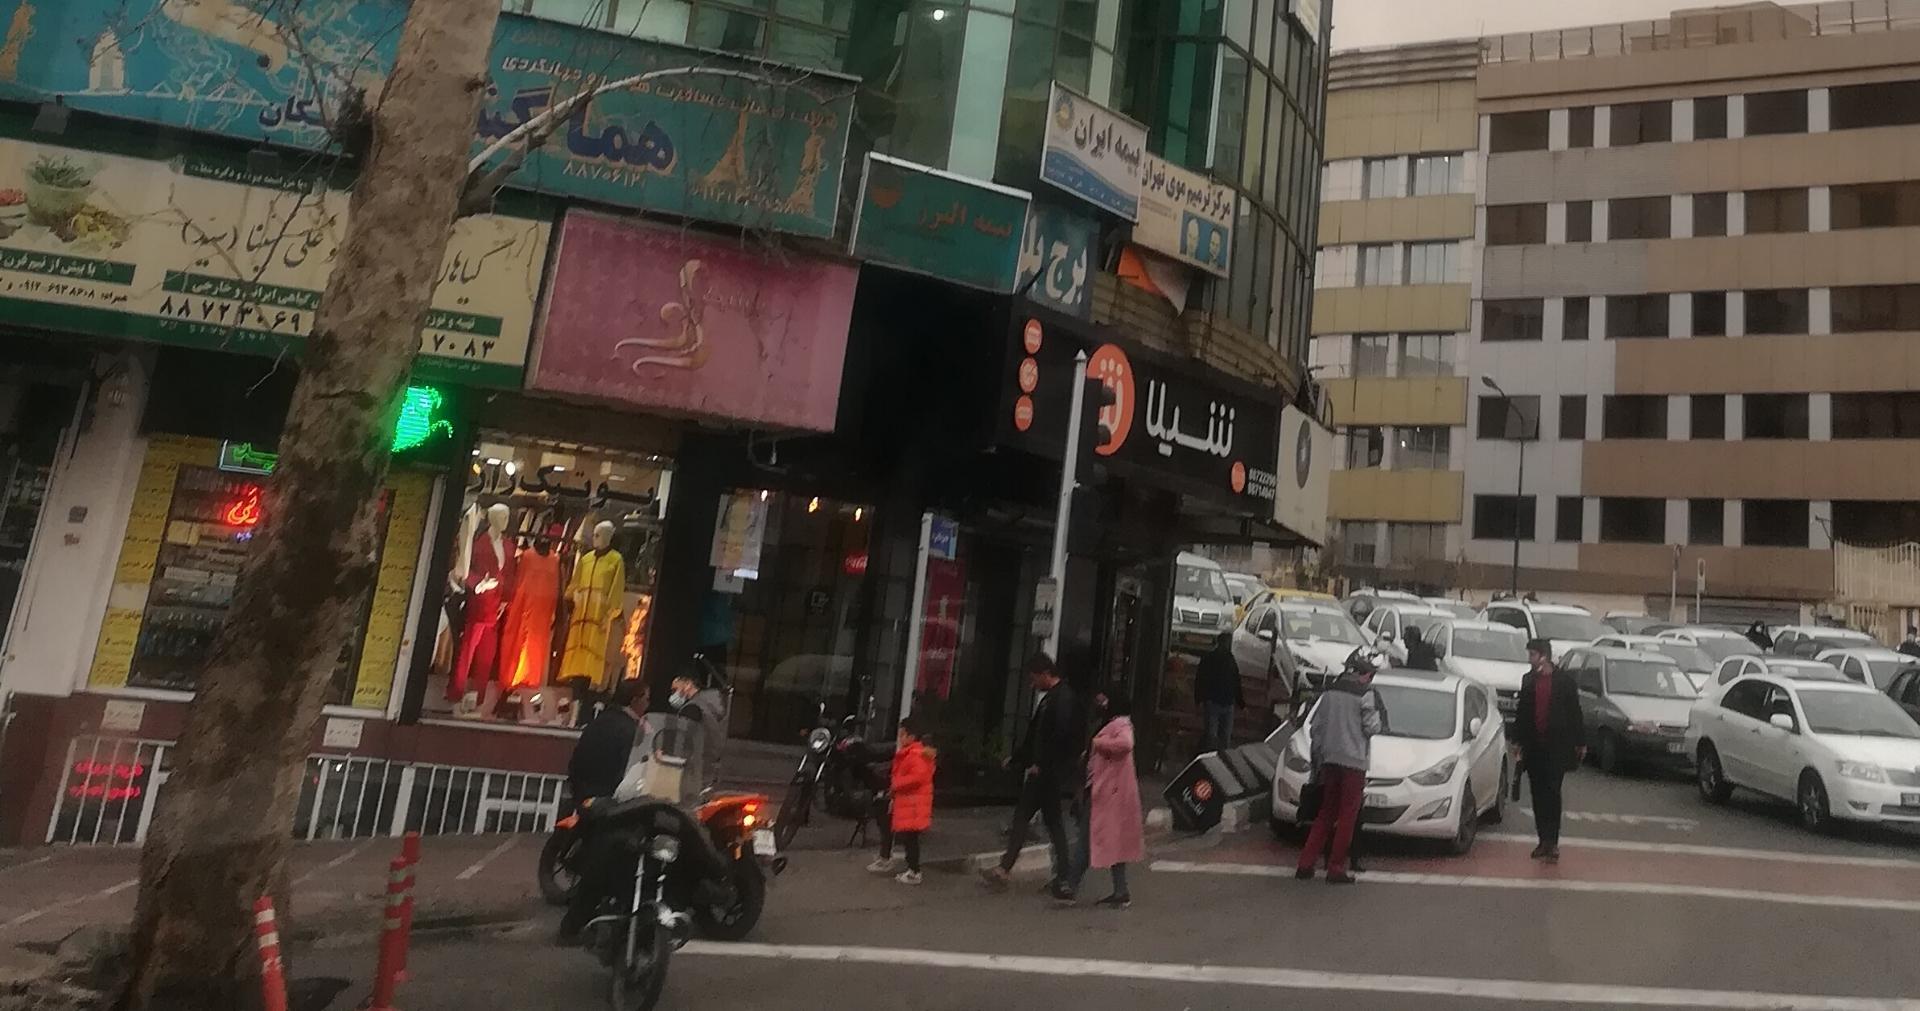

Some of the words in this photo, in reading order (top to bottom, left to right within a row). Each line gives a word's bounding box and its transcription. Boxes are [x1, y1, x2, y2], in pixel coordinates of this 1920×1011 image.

[502, 56, 583, 81] جهانگردی
[567, 100, 674, 170] هما
[1073, 113, 1113, 161] ایران
[1114, 135, 1141, 176] بیمه
[1142, 159, 1166, 192] تهران
[1165, 174, 1186, 202] موی
[1186, 184, 1212, 212] ترمیم
[1211, 187, 1231, 220] مرکز
[919, 199, 968, 231] البرز
[973, 212, 1013, 238] بیمه
[282, 231, 324, 269] علی
[60, 259, 86, 276] بیش
[1044, 238, 1088, 305] برج
[192, 280, 232, 296] خارجی
[1144, 377, 1237, 459] شیلا
